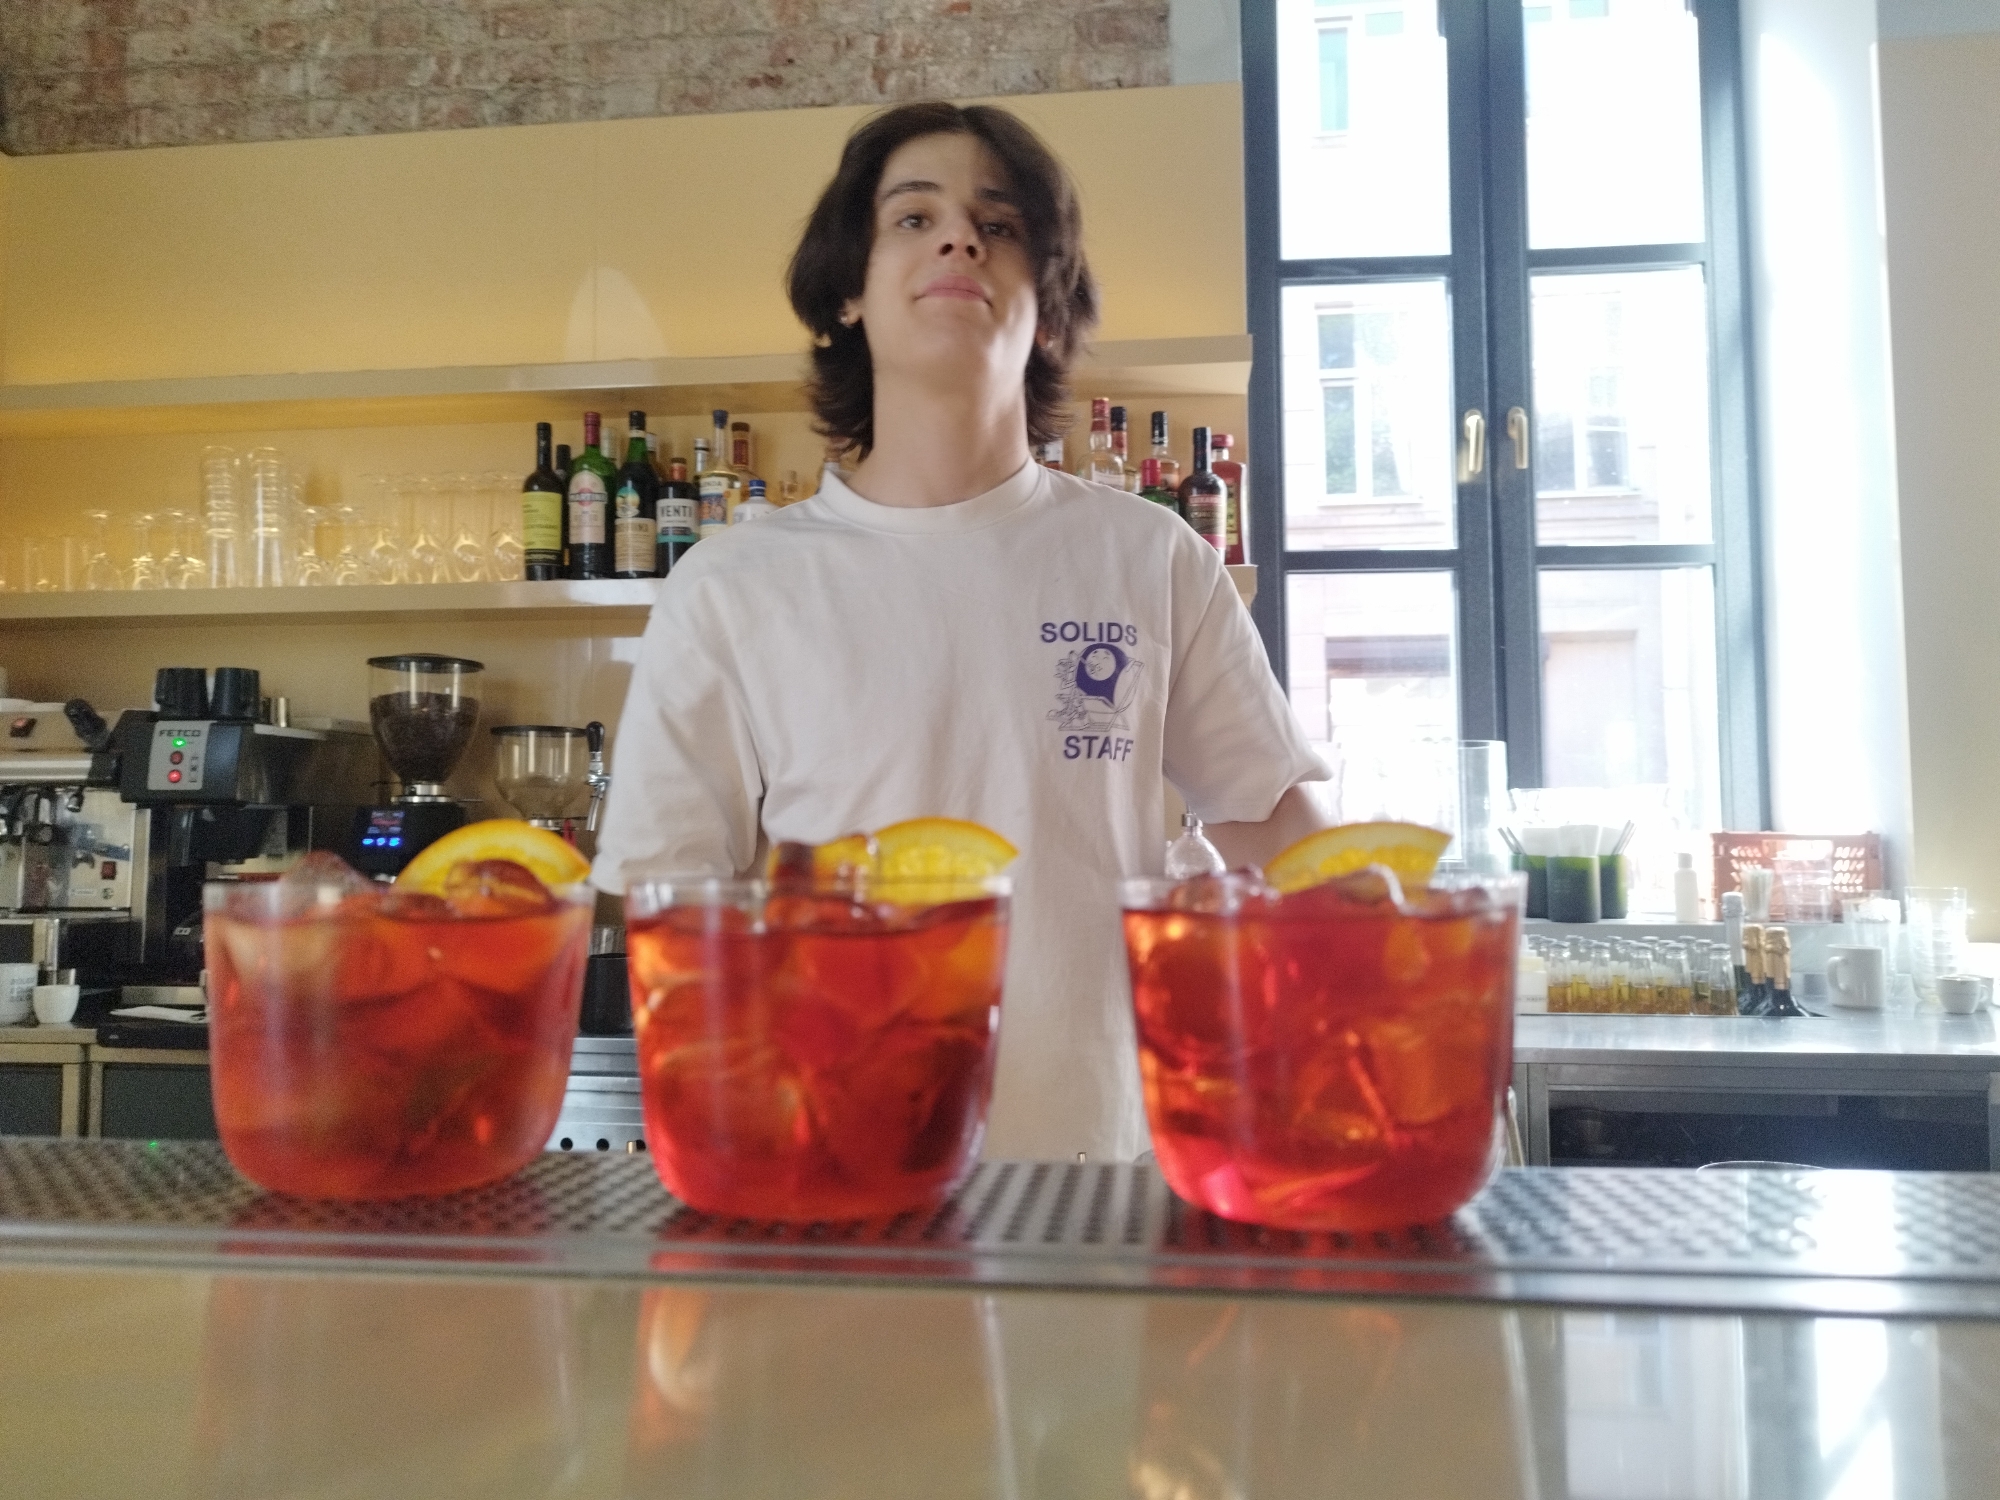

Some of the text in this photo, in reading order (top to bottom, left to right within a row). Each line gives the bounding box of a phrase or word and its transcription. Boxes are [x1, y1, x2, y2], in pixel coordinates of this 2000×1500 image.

[1041, 621, 1137, 646] SOLIDS
[159, 729, 201, 737] FETCO
[1064, 735, 1134, 761] STAFF
